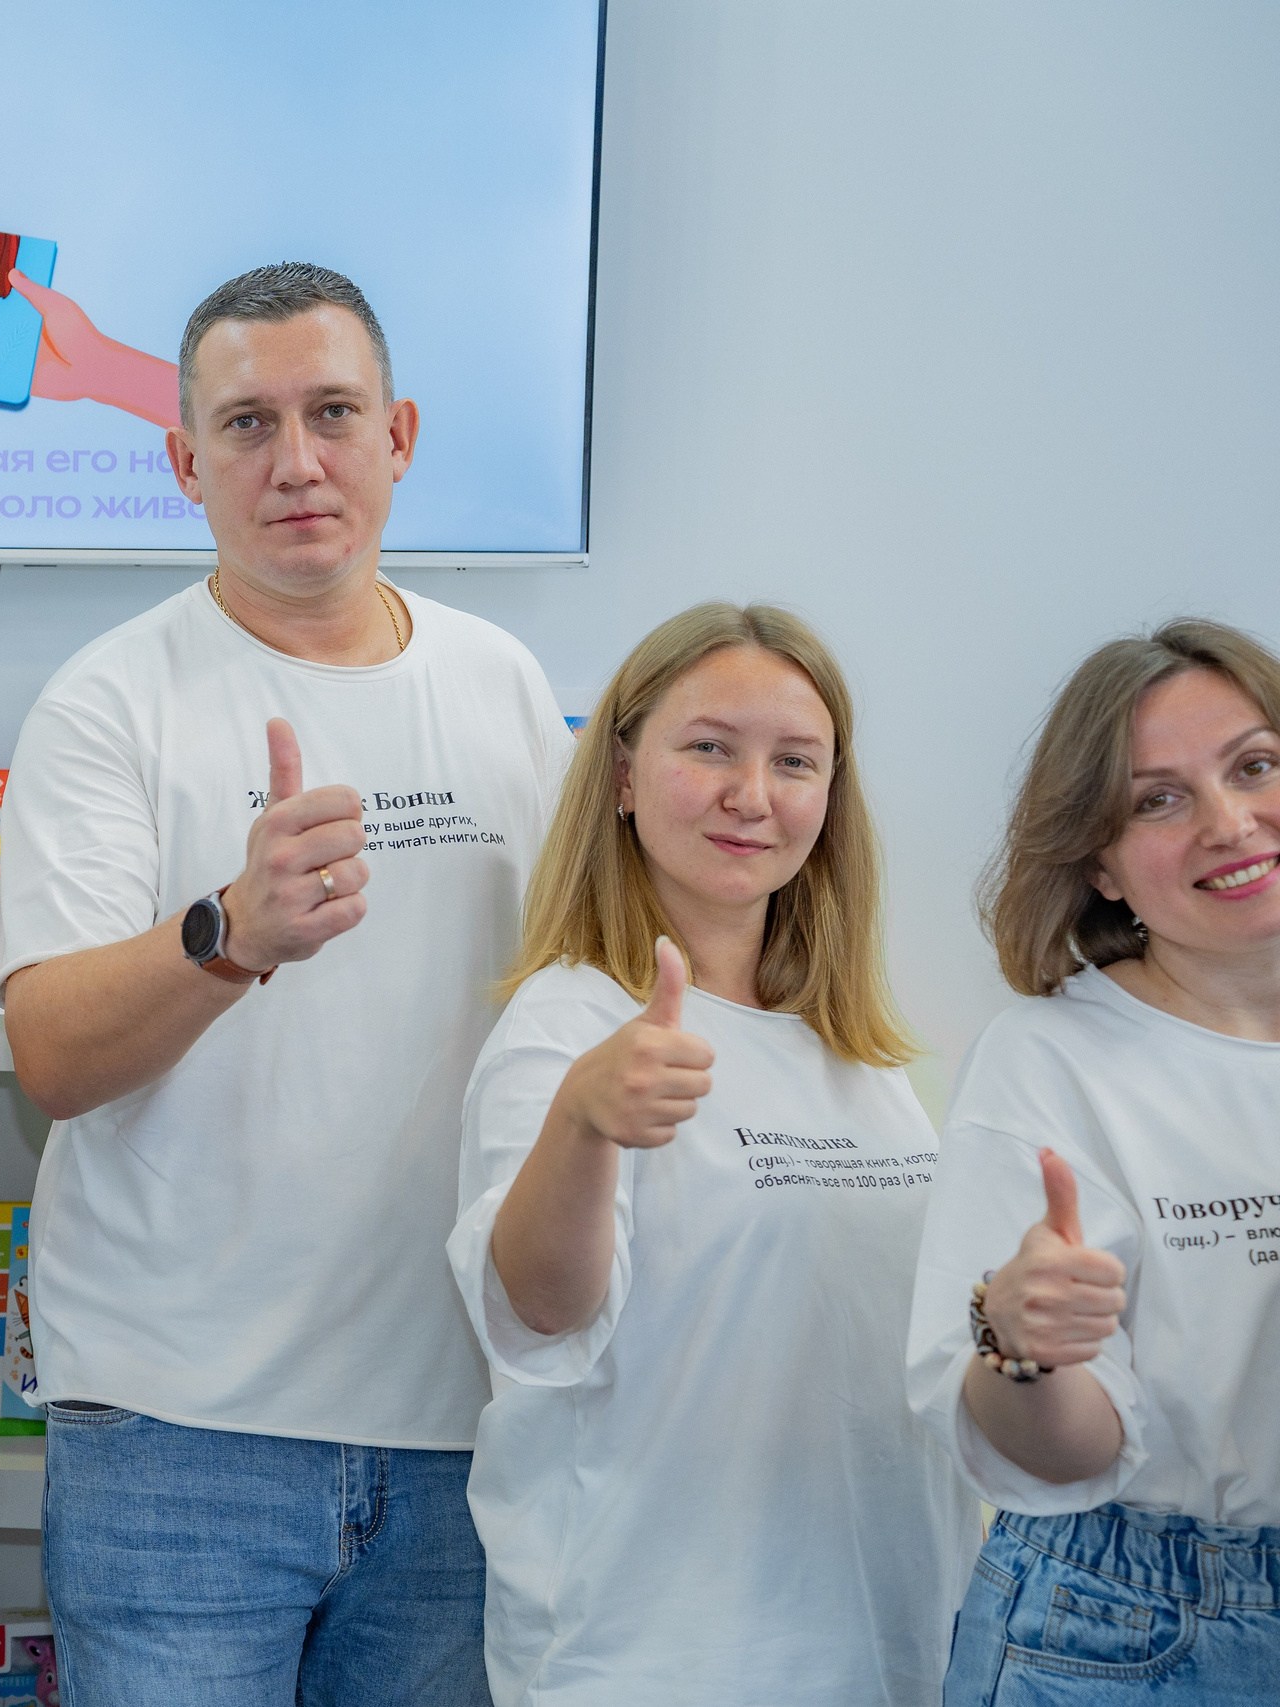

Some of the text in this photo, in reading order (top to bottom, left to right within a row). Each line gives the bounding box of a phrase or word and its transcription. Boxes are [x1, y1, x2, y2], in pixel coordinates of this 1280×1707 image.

[46, 450, 118, 473] его
[372, 791, 456, 811] Бонни
[363, 815, 477, 835] ву выше других,
[362, 832, 506, 851] еет читать книги САМ
[733, 1127, 859, 1150] Нажималка
[804, 1158, 864, 1171] говорящая
[865, 1157, 904, 1168] книга,
[903, 1152, 939, 1165] котор
[754, 1172, 822, 1189] объяснять
[822, 1175, 840, 1188] все
[841, 1177, 855, 1189] по
[856, 1175, 877, 1188] 100
[878, 1175, 901, 1190] раз
[902, 1172, 915, 1188] (а
[1152, 1194, 1280, 1221] Говоруч
[1246, 1227, 1280, 1240] влю
